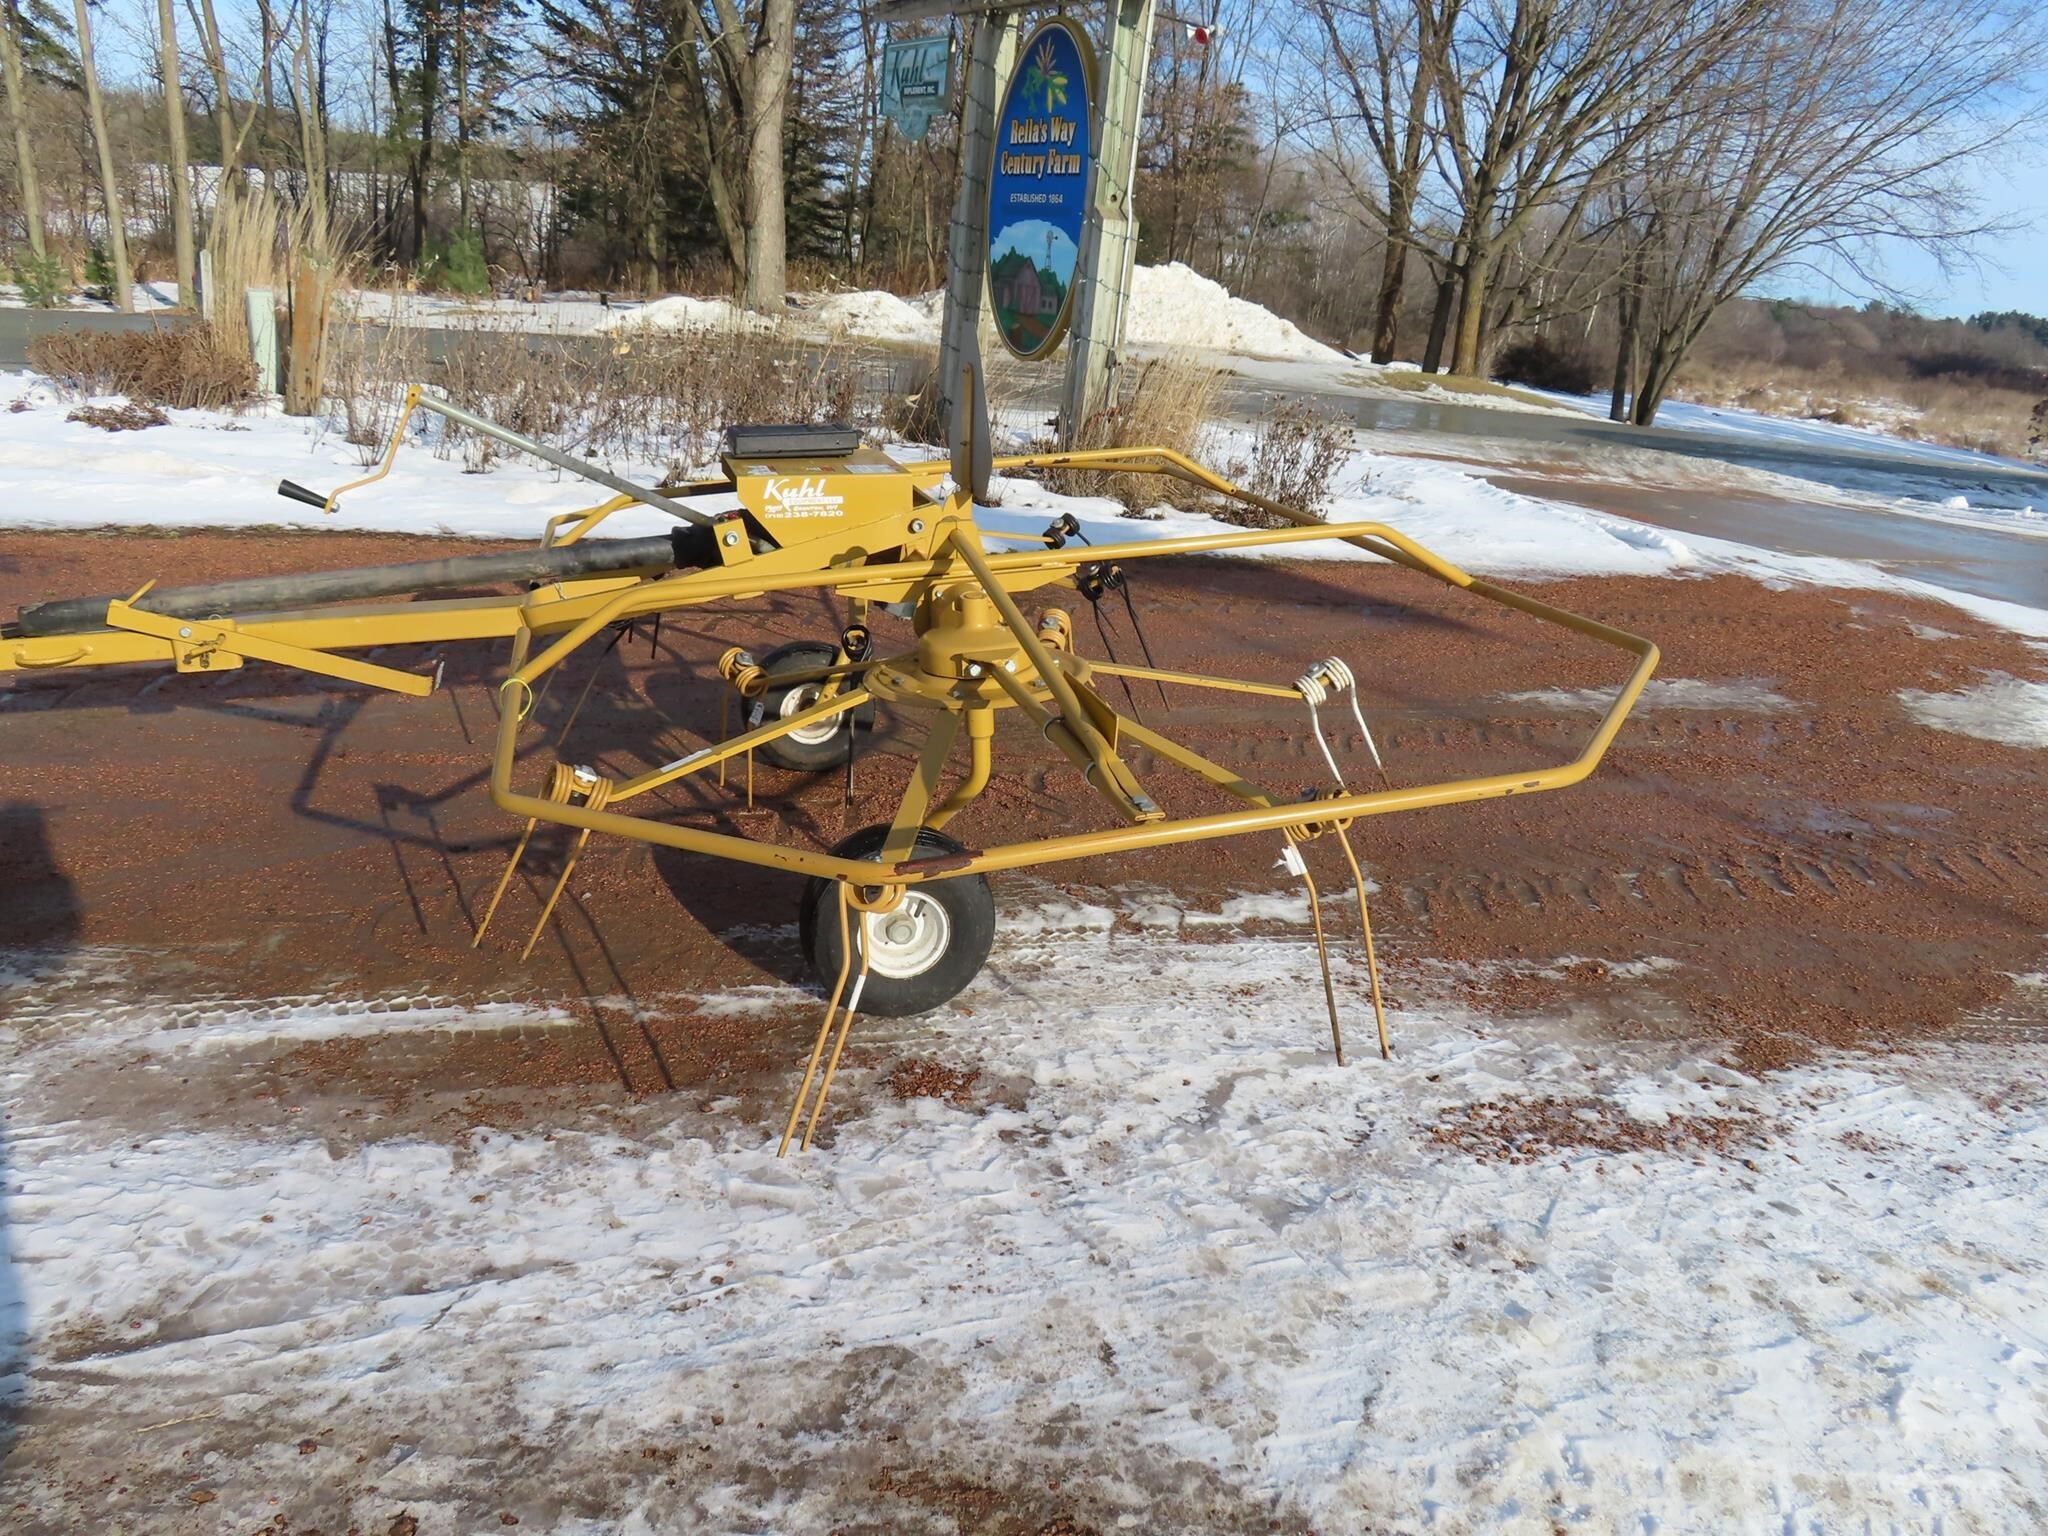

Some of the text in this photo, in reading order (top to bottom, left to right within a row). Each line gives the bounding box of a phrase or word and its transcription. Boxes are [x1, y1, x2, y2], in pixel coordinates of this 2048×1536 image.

[889, 48, 928, 102] Kuhl
[1051, 116, 1076, 146] Way
[1000, 148, 1081, 180] Century Farm
[1010, 193, 1047, 203] ESTABLISHED
[763, 478, 826, 511] Kuhl
